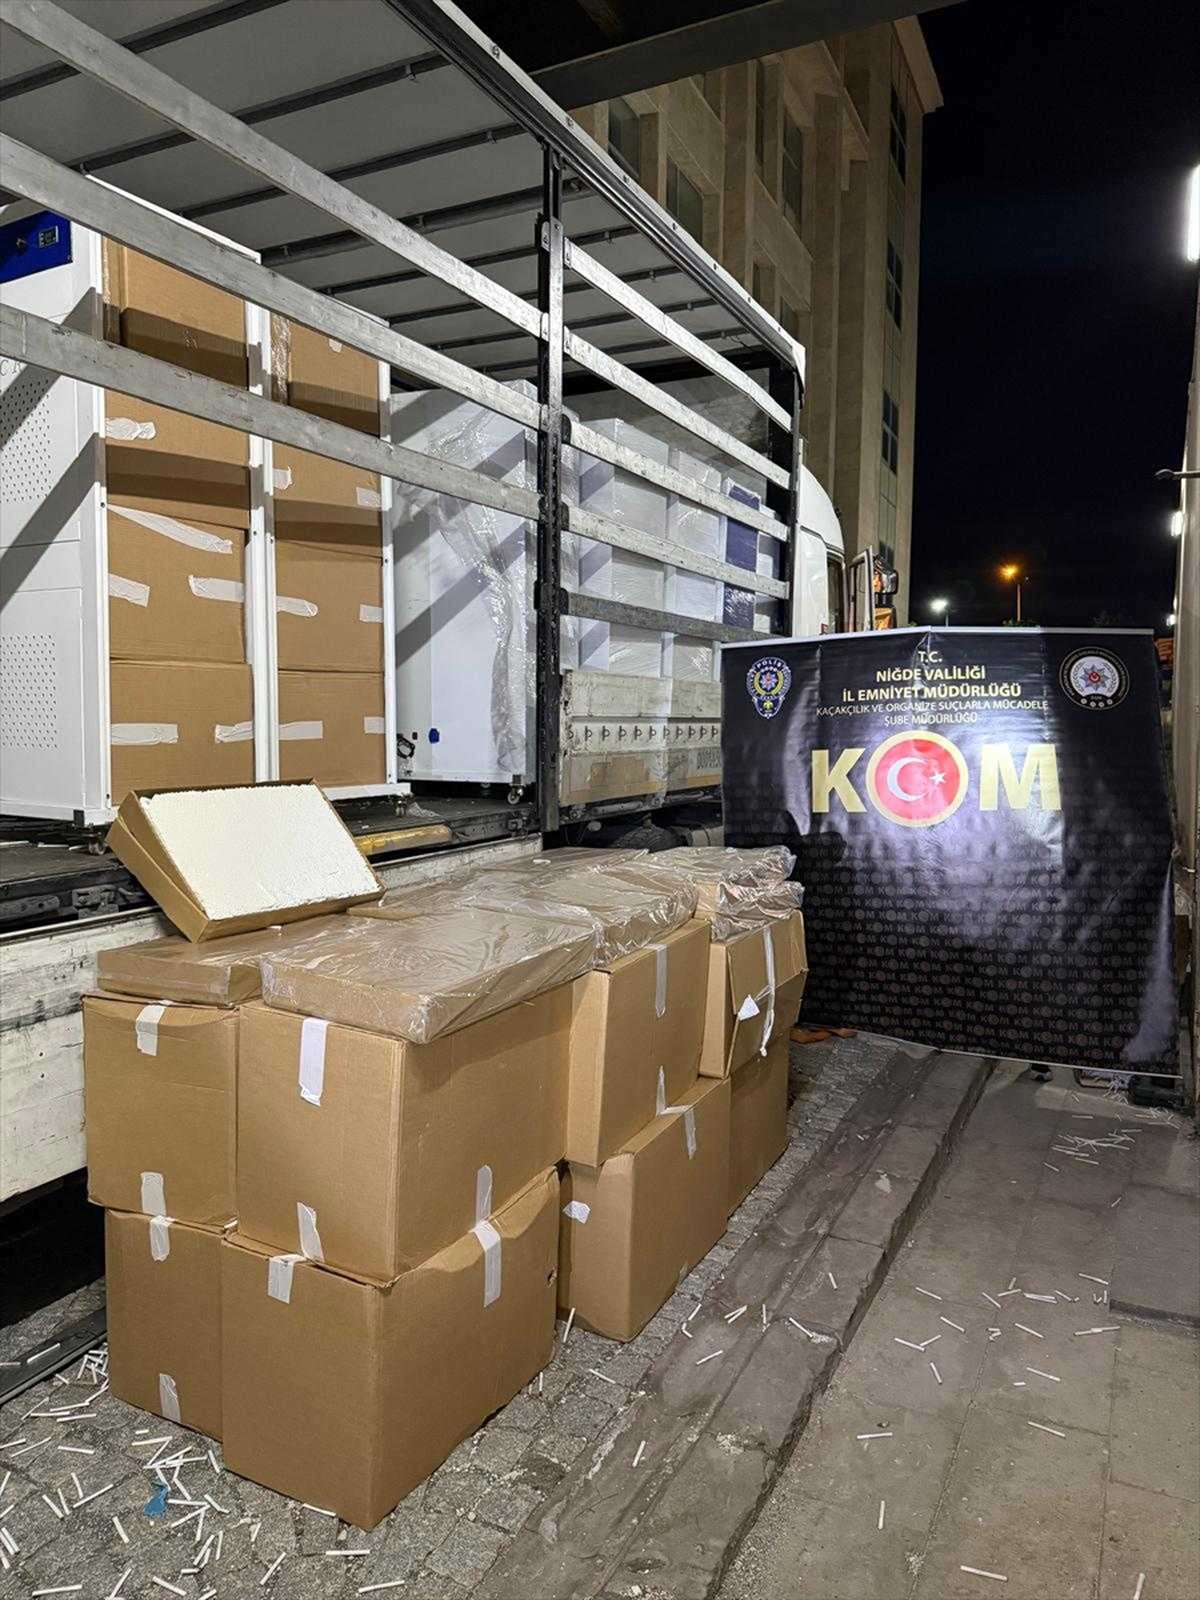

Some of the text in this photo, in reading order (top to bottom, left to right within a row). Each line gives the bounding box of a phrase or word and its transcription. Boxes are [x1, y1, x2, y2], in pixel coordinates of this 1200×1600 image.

[918, 651, 942, 664] T.C.
[876, 665, 986, 682] NİĞDE VALİLİĞİ
[843, 681, 1022, 702] İL EMNİYET MÜDÜRLÜĞÜ
[815, 698, 1049, 717] KAÇAKÇILIK VE ORGANİZE SUÇLARLA MÜCADELE
[884, 711, 979, 727] ŞUBE MÜDÜRLÜĞÜ
